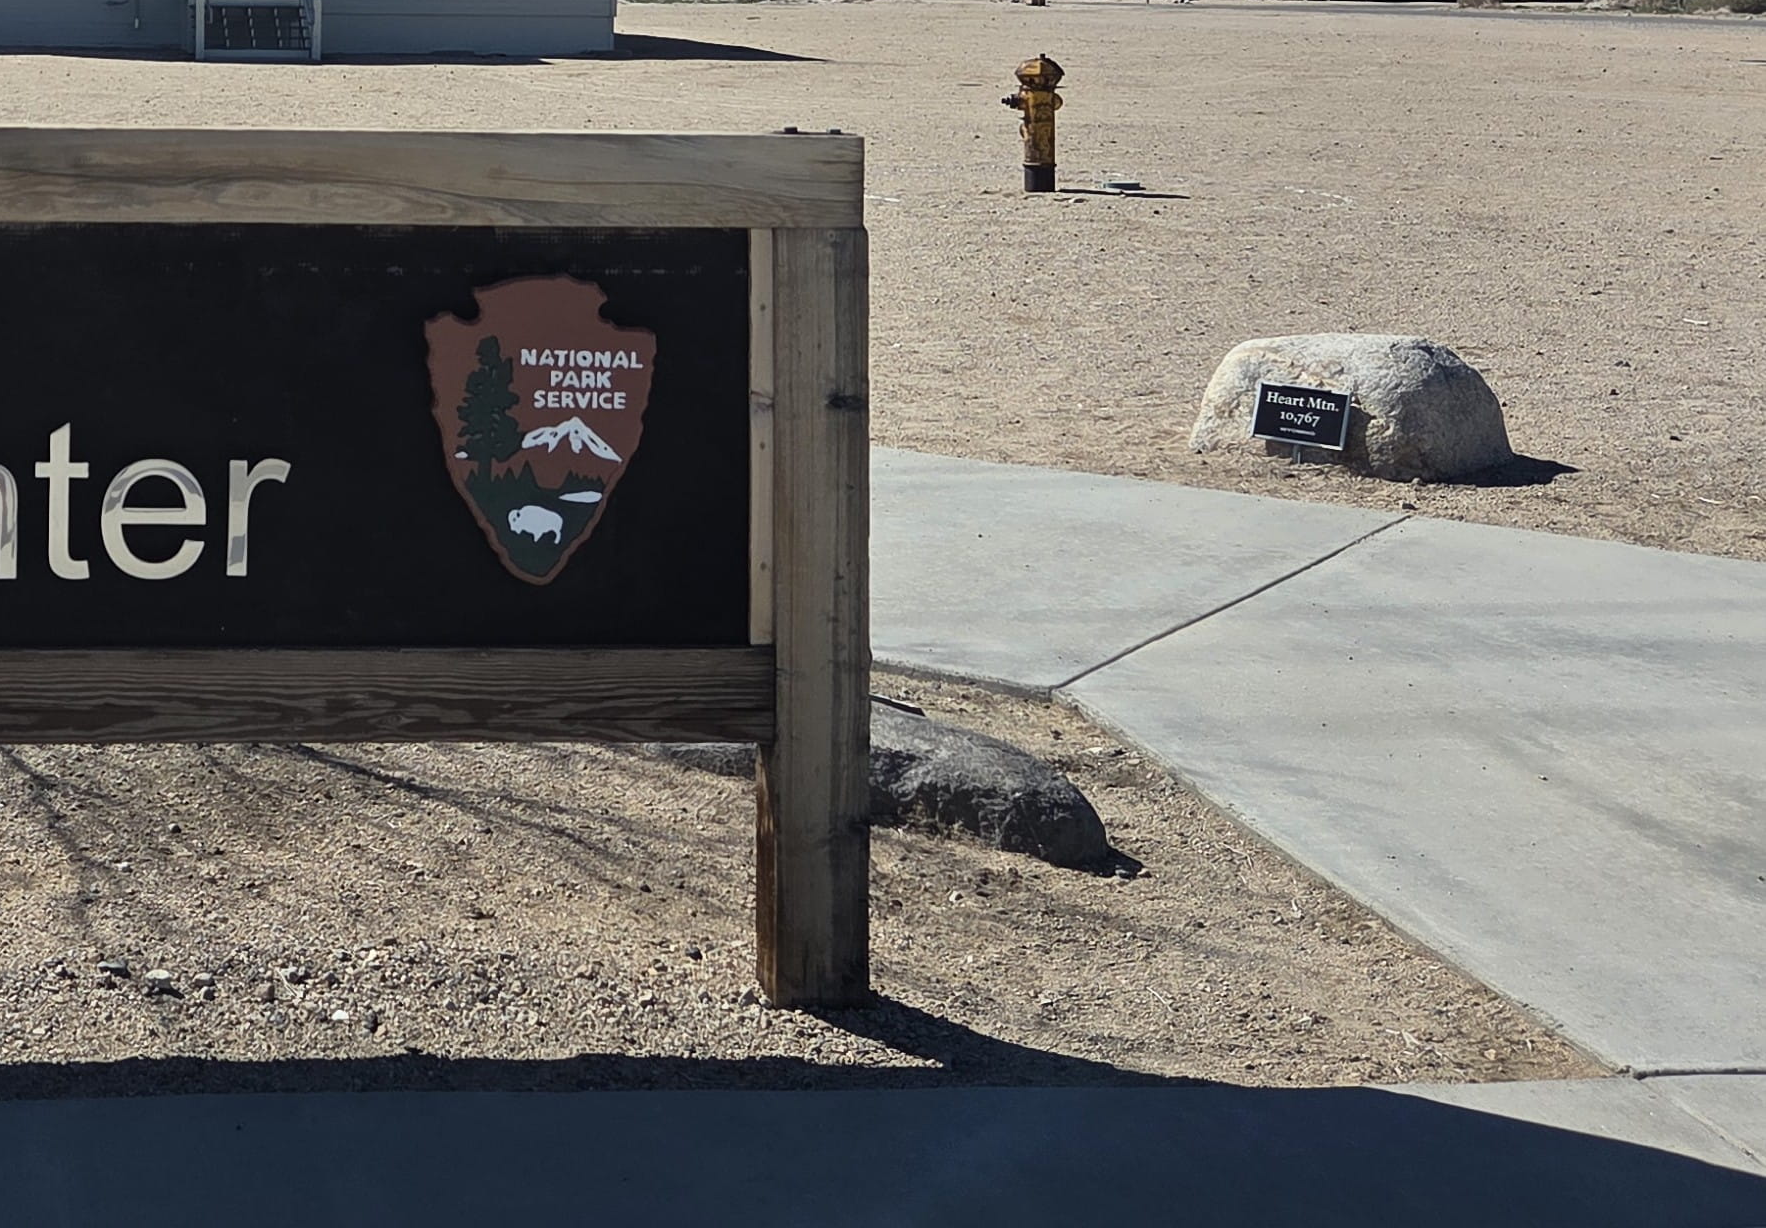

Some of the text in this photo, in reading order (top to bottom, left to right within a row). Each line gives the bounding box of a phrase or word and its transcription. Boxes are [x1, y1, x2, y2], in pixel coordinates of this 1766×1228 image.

[520, 348, 644, 369] NATIONAL
[550, 370, 612, 389] PARK
[533, 389, 627, 410] SERVICE
[1266, 391, 1339, 412] Heart Mtn.
[1281, 411, 1320, 427] 10,767
